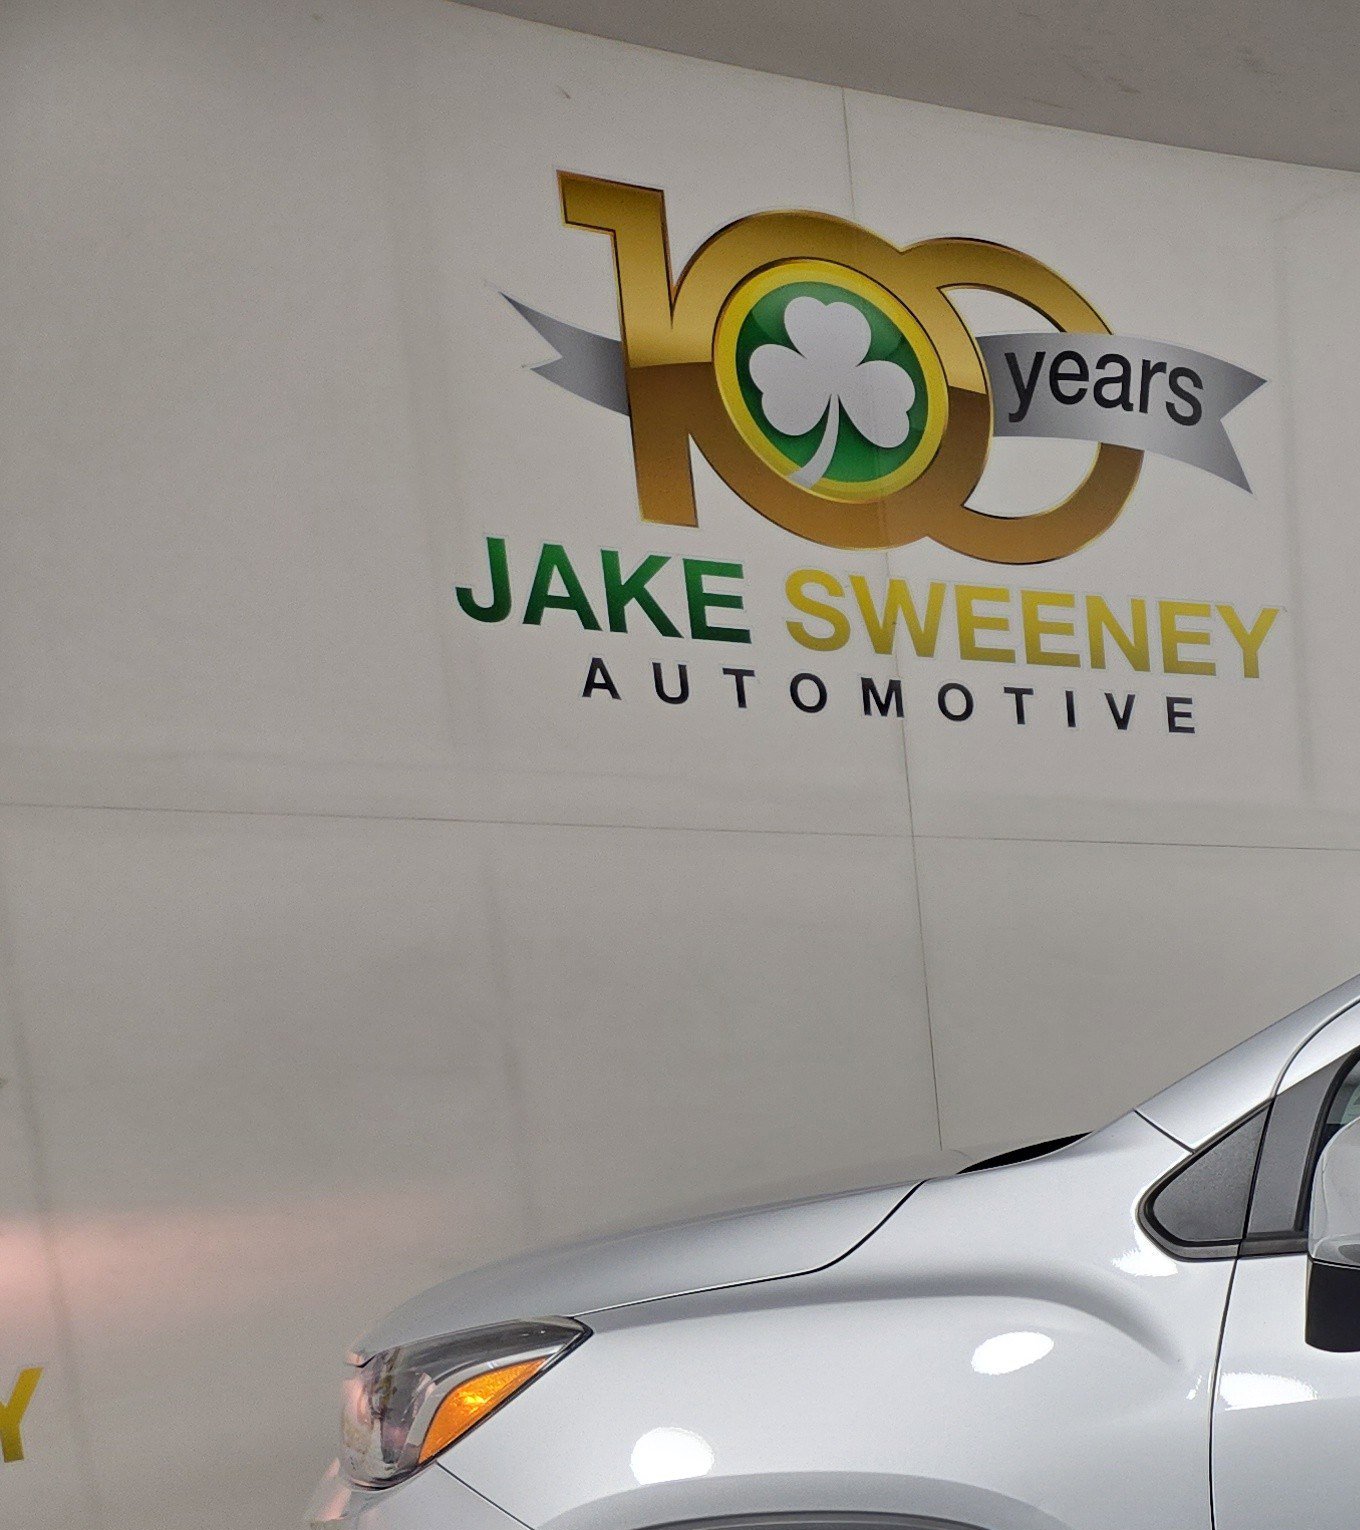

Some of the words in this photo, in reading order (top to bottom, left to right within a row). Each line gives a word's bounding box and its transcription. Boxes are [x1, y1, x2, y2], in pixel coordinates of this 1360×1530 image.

[556, 170, 1145, 566] 100
[1003, 349, 1205, 428] years
[454, 537, 752, 645] JAKE
[783, 567, 1282, 680] SWEENEY
[582, 657, 1197, 735] AUTOMOTIVE
